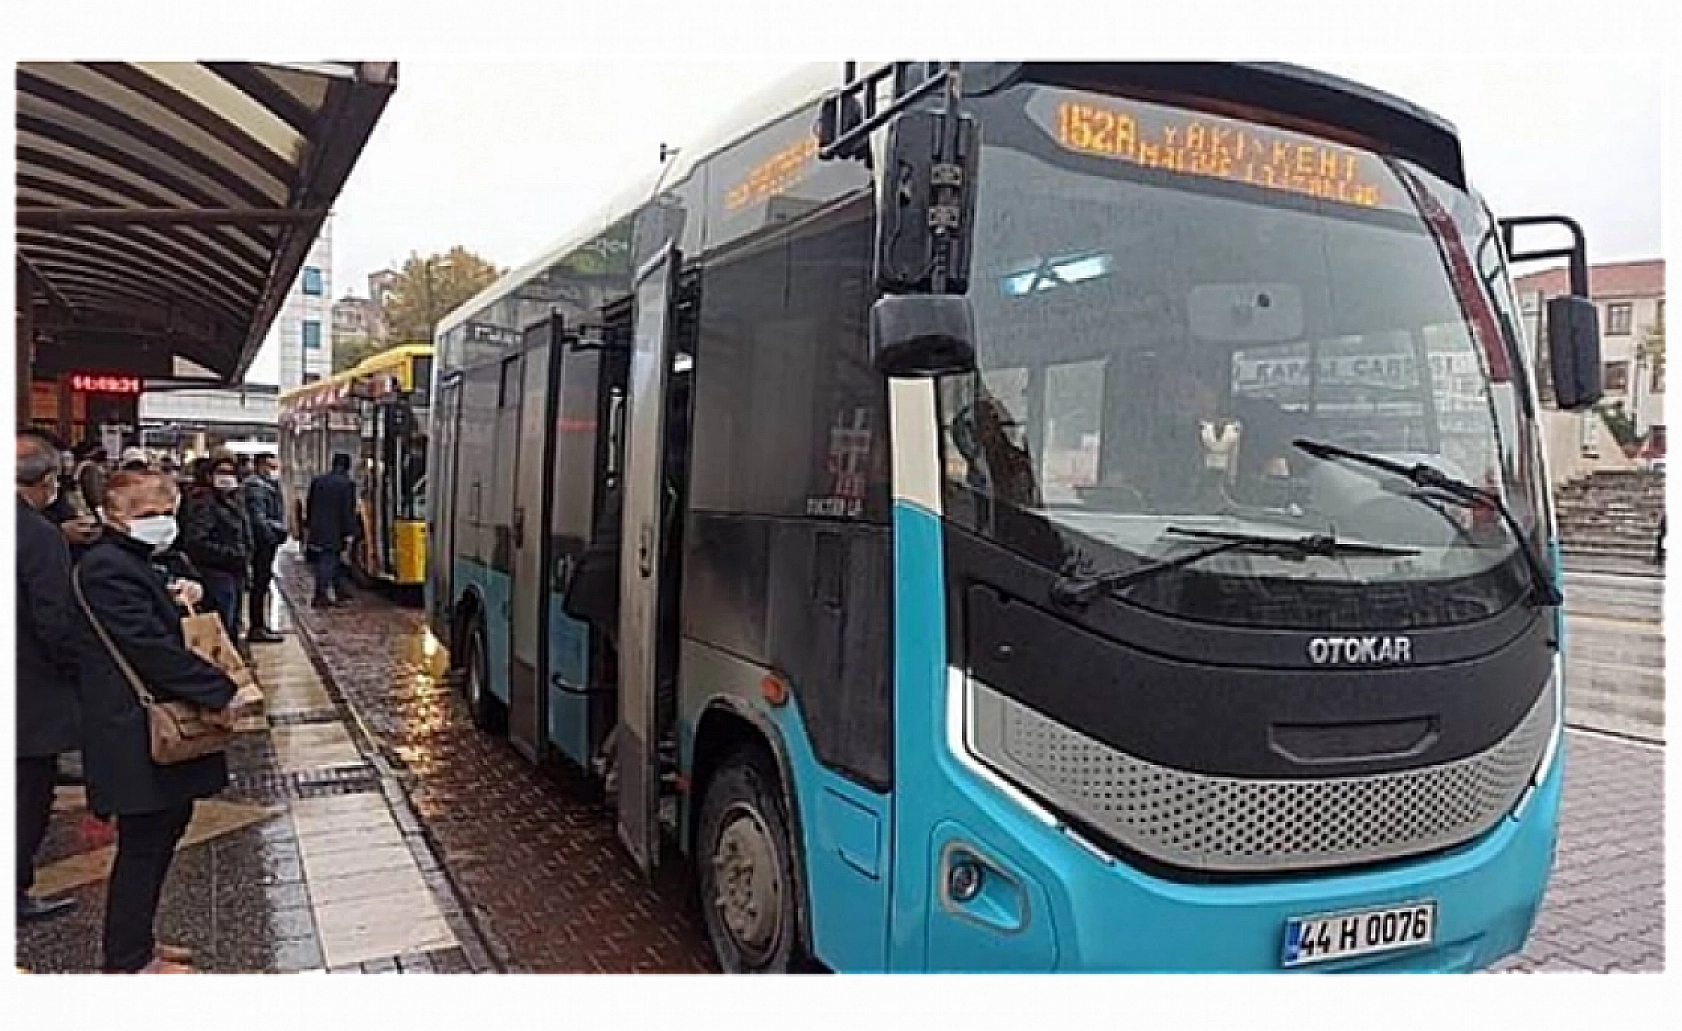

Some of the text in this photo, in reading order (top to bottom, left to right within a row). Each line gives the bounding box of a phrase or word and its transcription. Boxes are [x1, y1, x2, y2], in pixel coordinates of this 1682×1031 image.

[1056, 101, 1138, 155] 152A
[1308, 636, 1412, 664] OTOKAR
[1301, 908, 1429, 956] 44 H 0076
